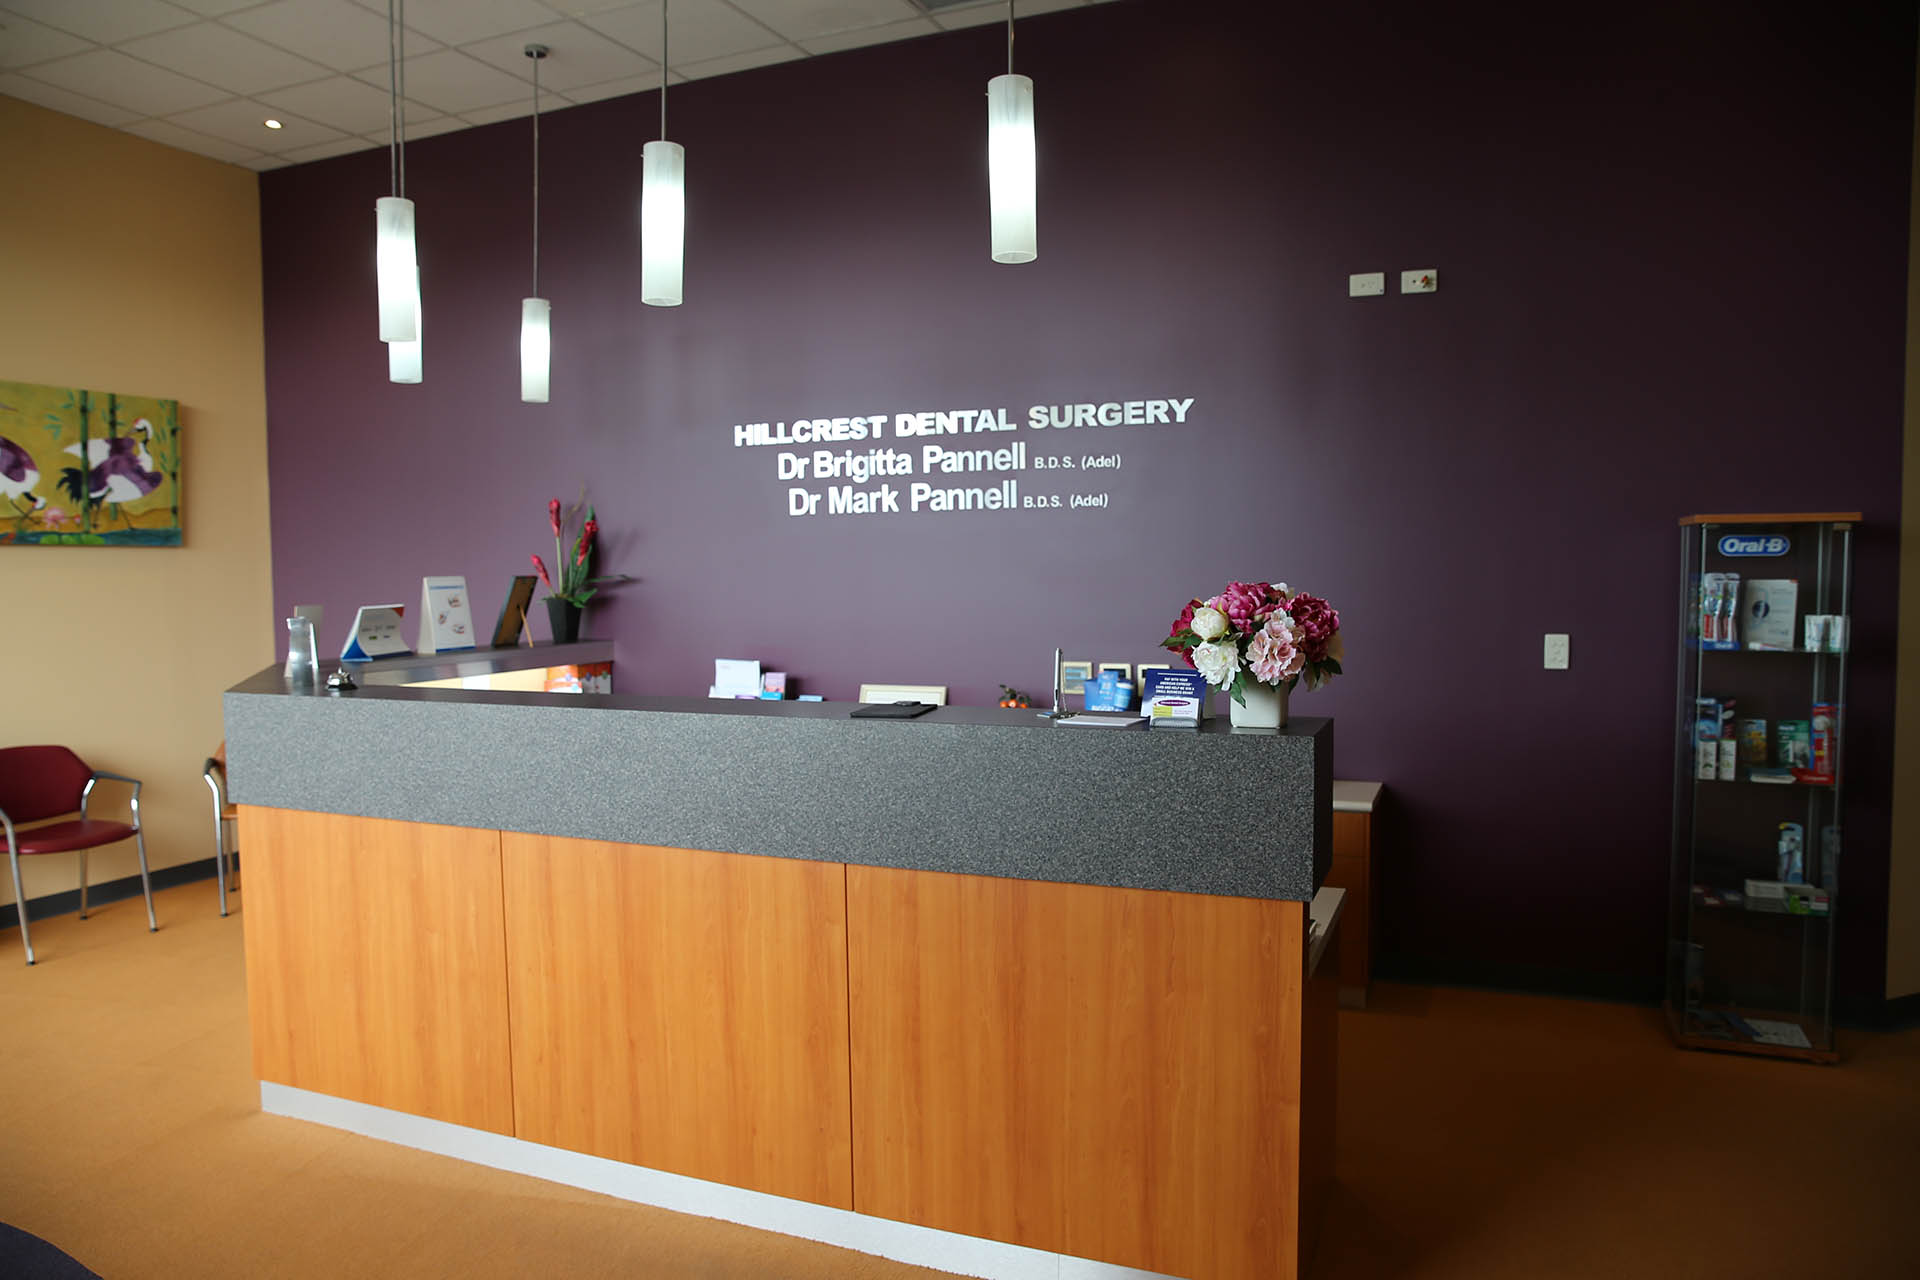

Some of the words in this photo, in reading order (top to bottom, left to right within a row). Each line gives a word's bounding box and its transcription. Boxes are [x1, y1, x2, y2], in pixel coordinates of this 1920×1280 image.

[734, 415, 888, 447] HILLCREST
[896, 408, 1017, 438] DENTAL
[1029, 399, 1195, 430] SURGERY
[778, 453, 811, 480] Dr
[814, 447, 913, 483] Brigitta
[923, 442, 1026, 474] Pannell
[1034, 455, 1076, 469] B.D.S.
[1081, 453, 1121, 470] (Adel)
[788, 487, 822, 516] Dr
[829, 483, 900, 515] Mark
[911, 479, 1018, 511] Pannell
[1023, 494, 1063, 508] B.D.S.
[1069, 492, 1109, 508] (Adel)
[1723, 537, 1785, 553] Oral-B
